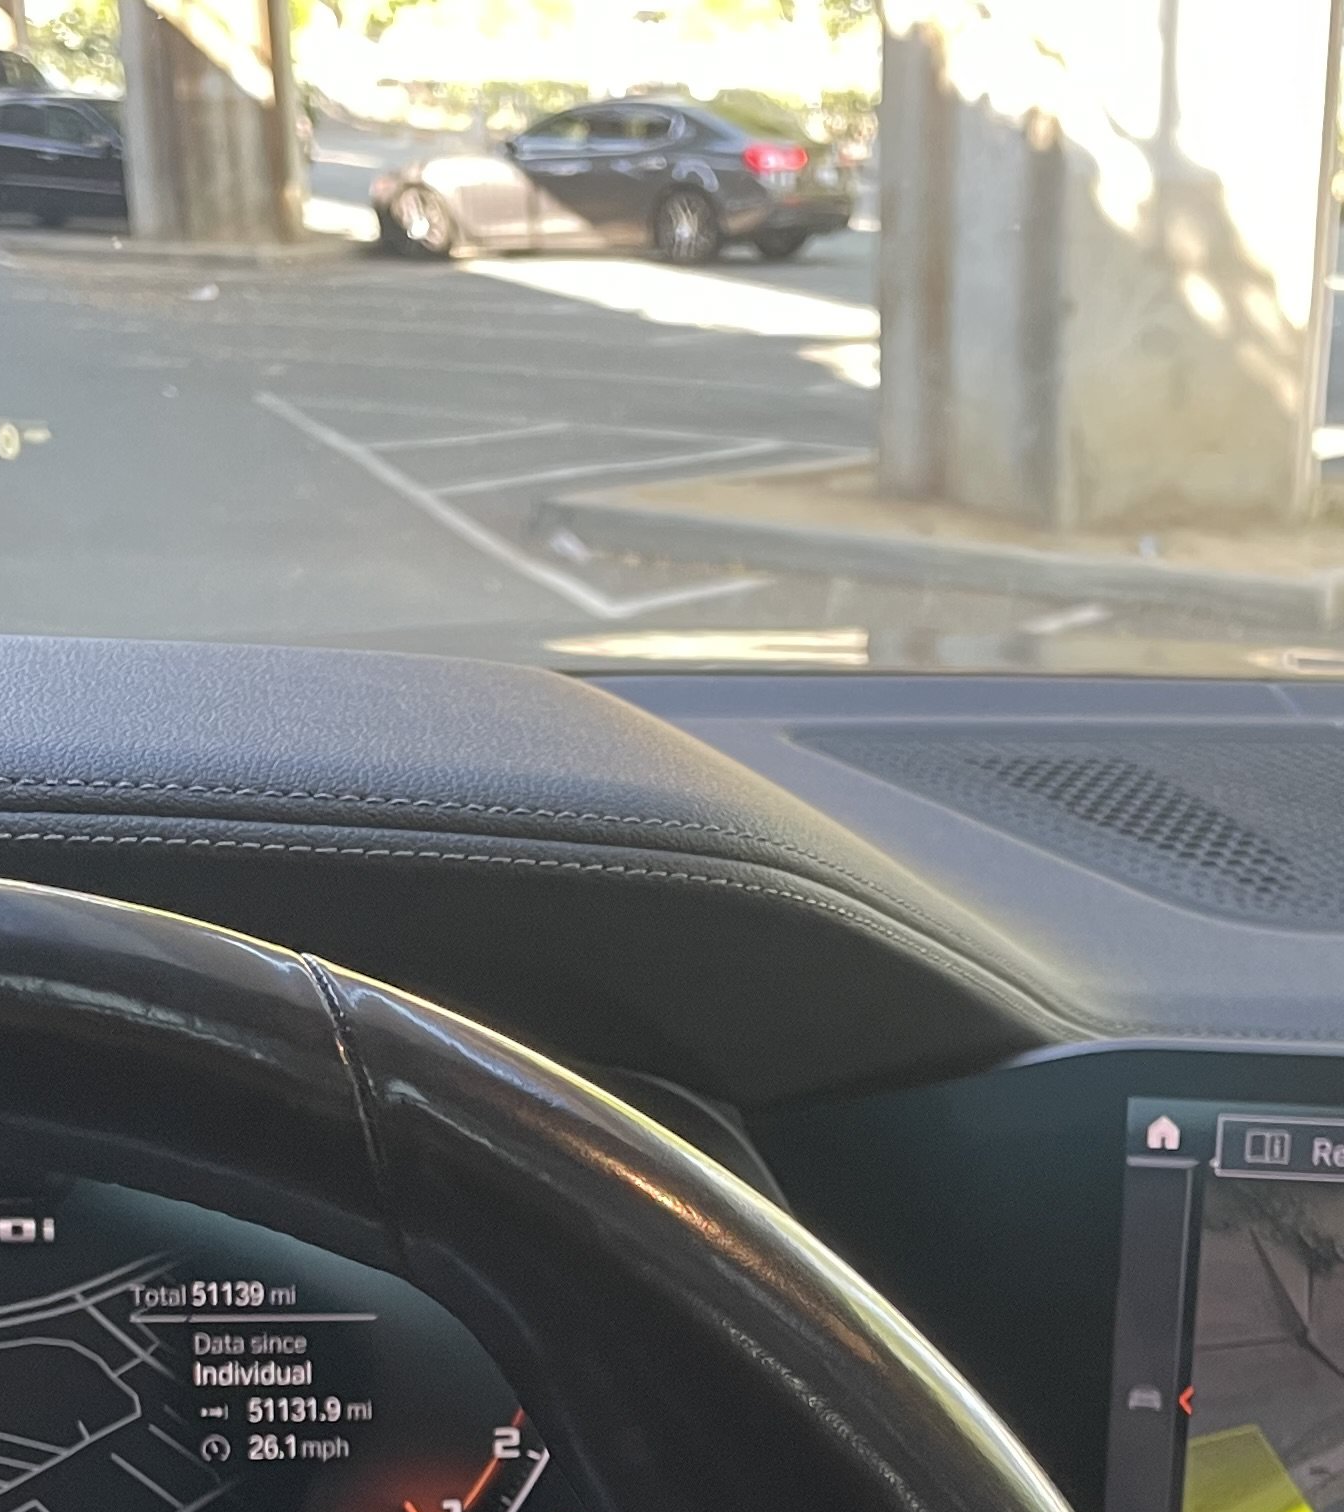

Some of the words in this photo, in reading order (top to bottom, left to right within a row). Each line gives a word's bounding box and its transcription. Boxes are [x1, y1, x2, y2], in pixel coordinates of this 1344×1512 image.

[132, 1285, 187, 1306] Total
[191, 1281, 265, 1307] 51139
[270, 1285, 297, 1306] mi
[193, 1332, 245, 1355] Data
[251, 1333, 307, 1355] since
[193, 1360, 312, 1386] Individual
[248, 1396, 342, 1422] 51131.9
[346, 1400, 373, 1421] mi
[248, 1434, 297, 1460] 26.1
[300, 1436, 350, 1462] mph
[493, 1427, 521, 1458] 2
